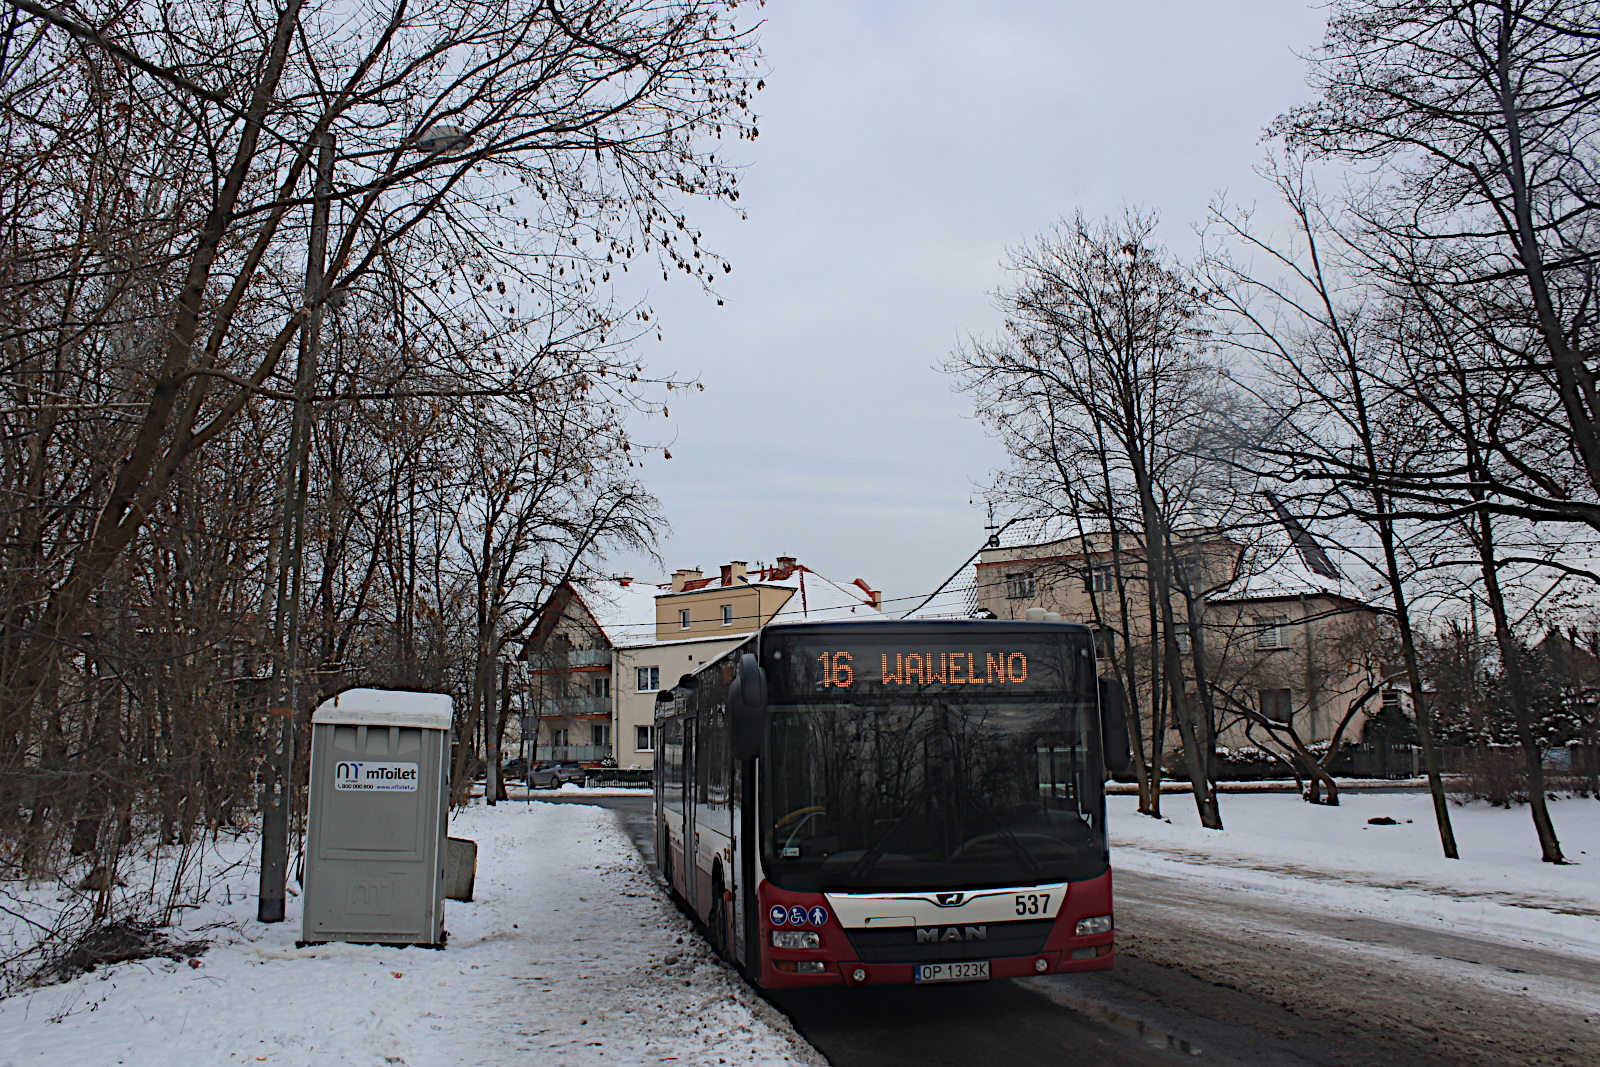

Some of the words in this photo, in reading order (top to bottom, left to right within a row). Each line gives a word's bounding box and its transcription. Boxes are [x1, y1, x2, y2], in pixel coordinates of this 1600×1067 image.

[817, 651, 854, 688] 16
[881, 652, 1028, 685] WAWELNO
[366, 767, 417, 780] mToilet
[1015, 894, 1051, 915] 537
[917, 926, 987, 943] MAN
[923, 965, 942, 979] OP
[947, 962, 987, 978] 1323K
